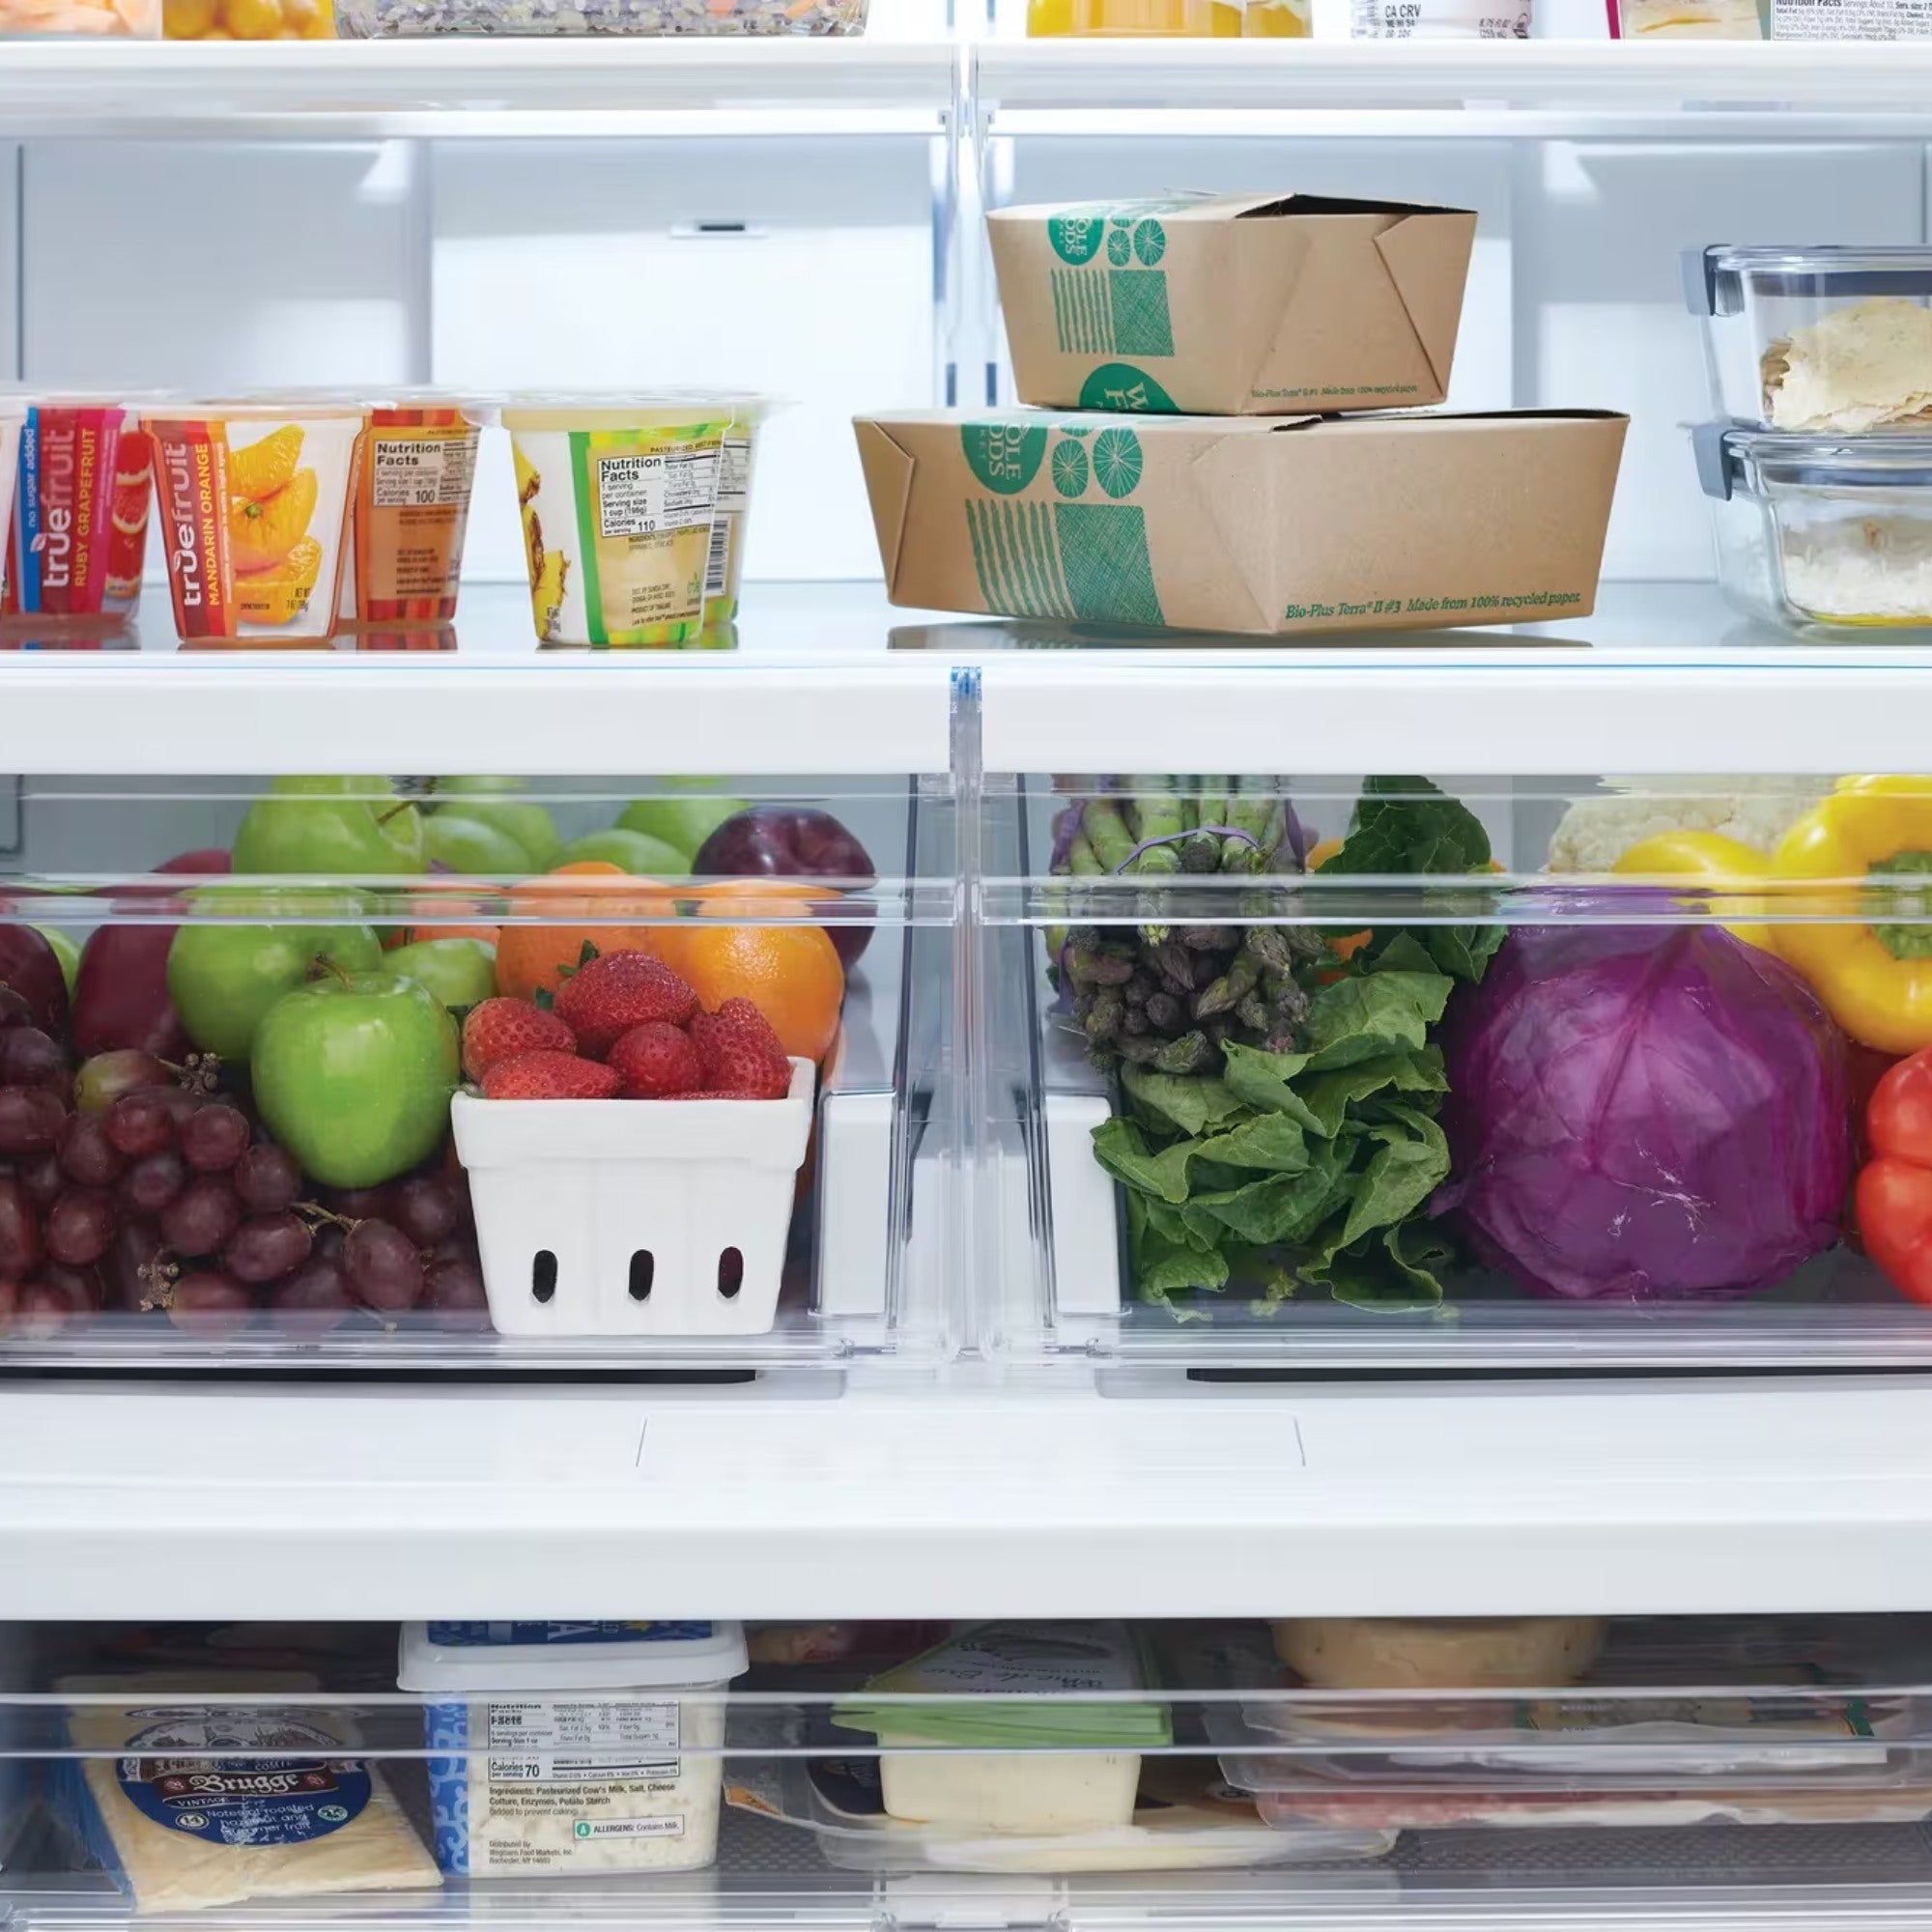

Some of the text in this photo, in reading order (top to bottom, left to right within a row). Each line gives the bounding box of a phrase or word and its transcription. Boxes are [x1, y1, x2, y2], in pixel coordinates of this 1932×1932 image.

[1384, 4, 1422, 18] CA CRV
[1065, 217, 1076, 255] ODS
[1076, 217, 1088, 256] OLE
[377, 442, 441, 454] Nutrition
[988, 424, 1005, 476] ODS
[1006, 424, 1023, 481] OLE
[377, 454, 419, 467] Facts
[601, 457, 663, 471] Nutrition
[24, 428, 37, 528] no sugar added
[601, 469, 640, 482] Facts
[377, 487, 436, 503] Calories 100
[43, 429, 75, 587] truefruit
[74, 428, 96, 586] RUBY GRAPEFRUIT
[603, 498, 631, 509] Serving
[166, 442, 201, 607] truefruit
[195, 443, 219, 606] MANDARIN ORANGE
[604, 518, 656, 531] Calories 110
[1286, 603, 1335, 619] Bio-Plus
[1383, 600, 1401, 613] #3
[1406, 597, 1438, 612] Made
[1440, 596, 1467, 611] from
[1470, 596, 1499, 609] 100%
[1501, 592, 1548, 610] recycled
[491, 1761, 540, 1777] Calories 70
[189, 1773, 299, 1792] Brugge
[489, 1786, 535, 1797] Ingredients:
[536, 1785, 582, 1796] Pasteurized
[582, 1785, 607, 1795] Cow's
[647, 1783, 675, 1792] Cheese
[177, 1796, 231, 1806] VINTAGE
[489, 1796, 611, 1807] Culture, Enzymes, Potato Starch
[265, 1804, 315, 1815] roasted
[524, 1808, 552, 1817] prevent
[593, 1824, 635, 1834] ALLERGENS:
